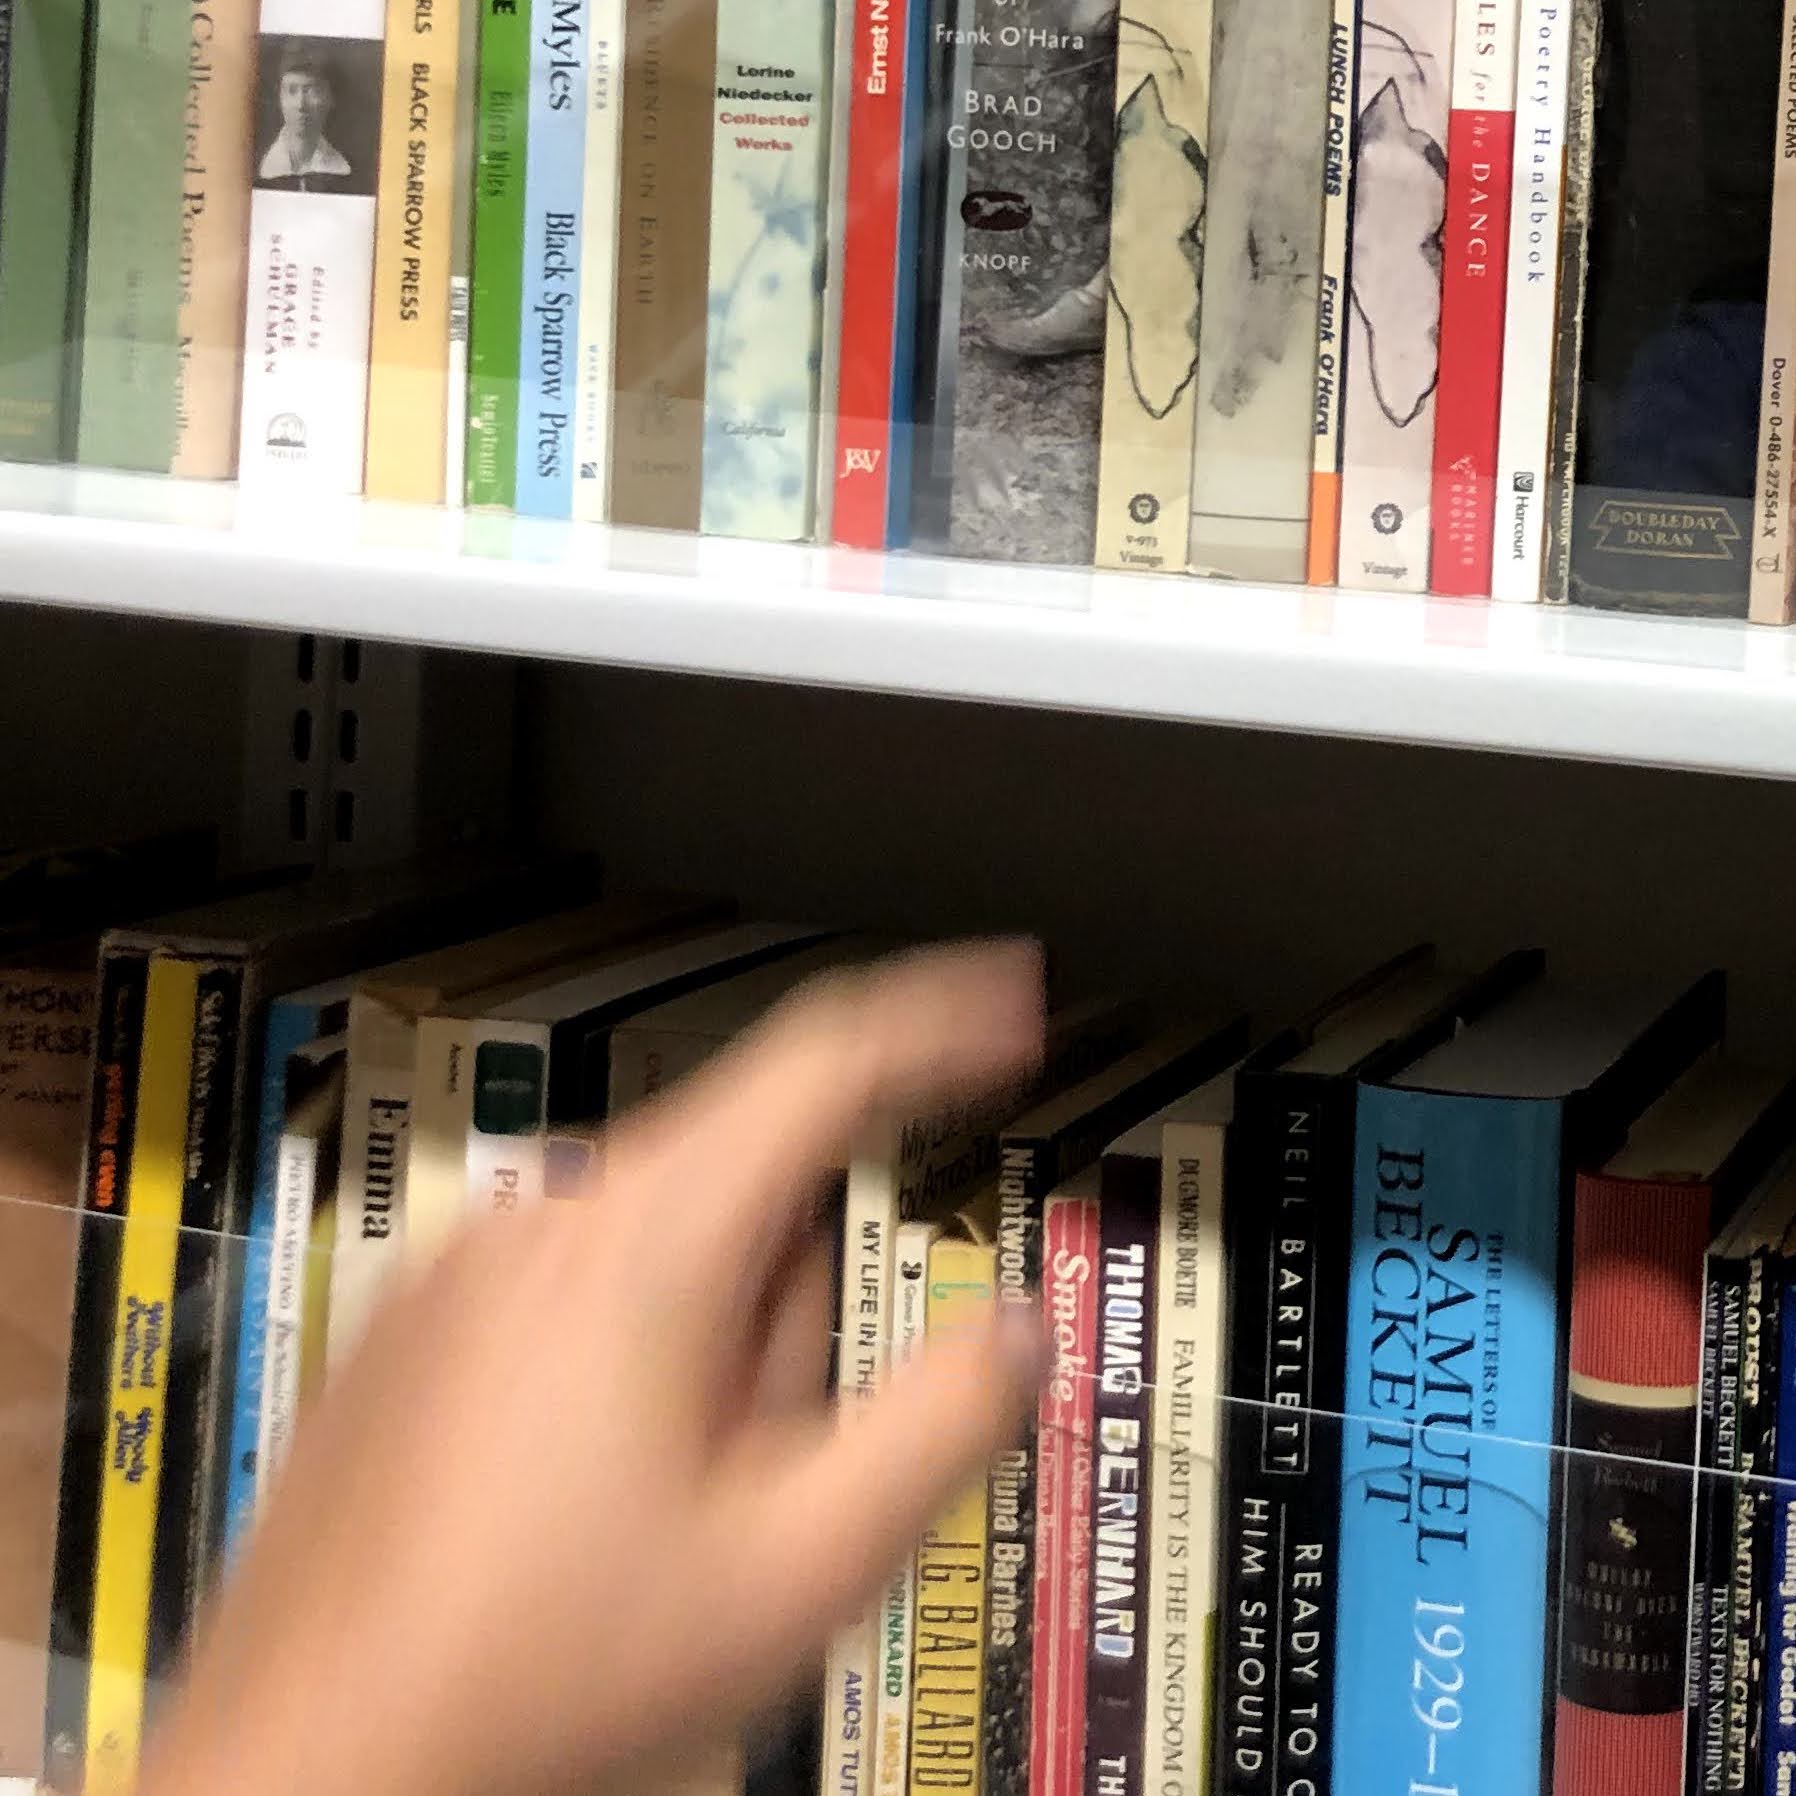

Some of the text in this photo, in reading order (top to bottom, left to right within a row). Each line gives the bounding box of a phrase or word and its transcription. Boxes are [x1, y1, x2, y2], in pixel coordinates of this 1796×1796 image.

[543, 1, 581, 110] Myles
[736, 65, 795, 78] Lorine
[867, 24, 889, 95] Ernst
[935, 23, 1085, 50] Frank O'Hara
[409, 62, 430, 132] BLACK
[717, 87, 813, 103] Niedecker
[719, 112, 809, 127] Collected
[964, 89, 1042, 117] BRAD
[1324, 22, 1348, 197] LUNCH POEMS
[1784, 99, 1796, 159] POEMS
[735, 136, 793, 151] Works
[946, 124, 1056, 153] GOOCH
[1528, 8, 1557, 283] Poetry Handbook
[403, 139, 427, 250] SPARROW
[1466, 163, 1490, 278] DANCE
[399, 257, 421, 322] PRESS
[958, 253, 1032, 273] KNOPF
[534, 212, 575, 478] Black Sparrow Press
[1313, 274, 1338, 435] Frank O'Hara
[1771, 358, 1786, 408] Dover
[1119, 550, 1164, 568] Vintage
[1512, 496, 1529, 560] Harcourt
[1607, 509, 1720, 531] DOUBLEDAY
[1624, 529, 1694, 547] DORAN
[1362, 561, 1408, 578] Vintage
[363, 1098, 411, 1239] Emma
[862, 1221, 880, 1258] MY
[998, 1148, 1036, 1305] Nightwood
[859, 1263, 879, 1314] LIFE
[1174, 1248, 1198, 1309] BOETIE
[1272, 1110, 1310, 1467] NEIL BARTLETT
[857, 1323, 877, 1346] IN
[1049, 1250, 1090, 1403] Smoke
[1364, 1143, 1426, 1524] BECKETT
[1481, 1285, 1502, 1397] LETTERS
[1743, 1256, 1762, 1407] PROUST
[1417, 1224, 1481, 1566] SAMUEL
[1717, 1284, 1741, 1469] SAMUEL BECKETT
[1095, 1243, 1145, 1657] THOMAS BERNHARD
[1168, 1339, 1195, 1527] FAMILIARITY
[1166, 1534, 1190, 1558] IS
[1735, 1492, 1757, 1624] SAMUEL
[990, 1541, 1026, 1648] Barnes
[1165, 1570, 1188, 1623] THE
[1235, 1498, 1270, 1771] HIM SHOULD
[1290, 1543, 1322, 1679] READY
[841, 1670, 864, 1742] AMOS
[914, 1602, 979, 1788] BALLARD
[1161, 1631, 1187, 1774] KINGDOM
[1705, 1585, 1729, 1791] TEXTS FOR NOTHING
[1727, 1637, 1749, 1790] BECKETT
[1779, 1646, 1796, 1726] Godot
[1287, 1702, 1319, 1756] TO
